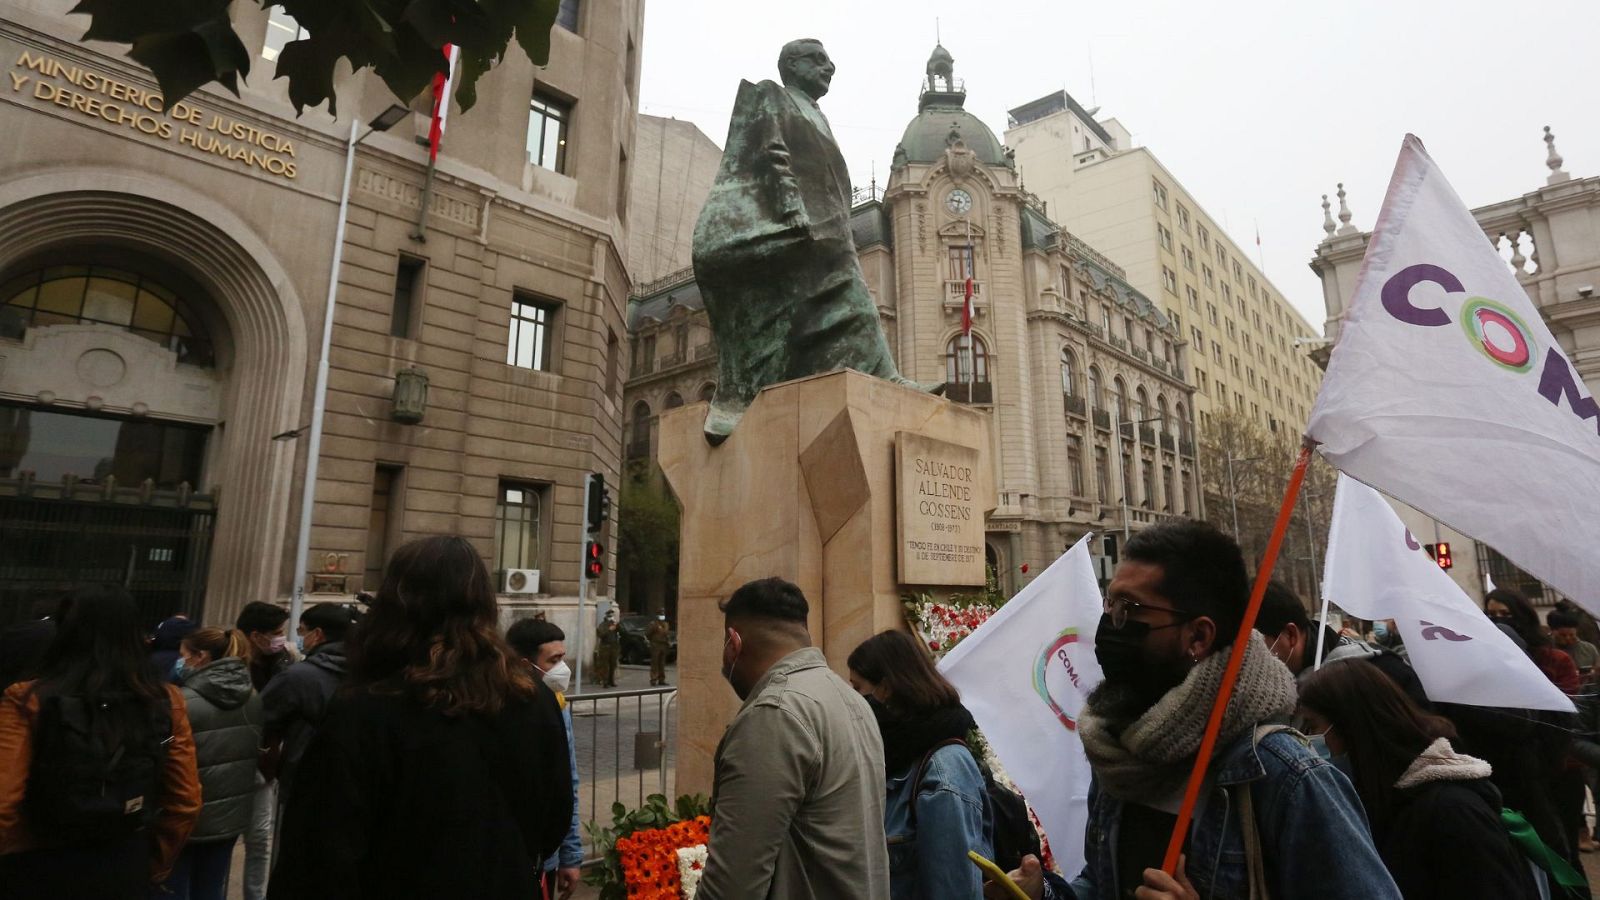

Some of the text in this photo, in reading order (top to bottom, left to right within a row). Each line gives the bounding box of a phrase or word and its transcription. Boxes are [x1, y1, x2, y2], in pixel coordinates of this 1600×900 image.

[9, 71, 297, 178] Y DERECHOS HUMANOS
[16, 51, 295, 157] MINISTERIO DE JUSTICIA
[916, 458, 972, 482] SALVADOR
[919, 481, 971, 501] ALLENDE
